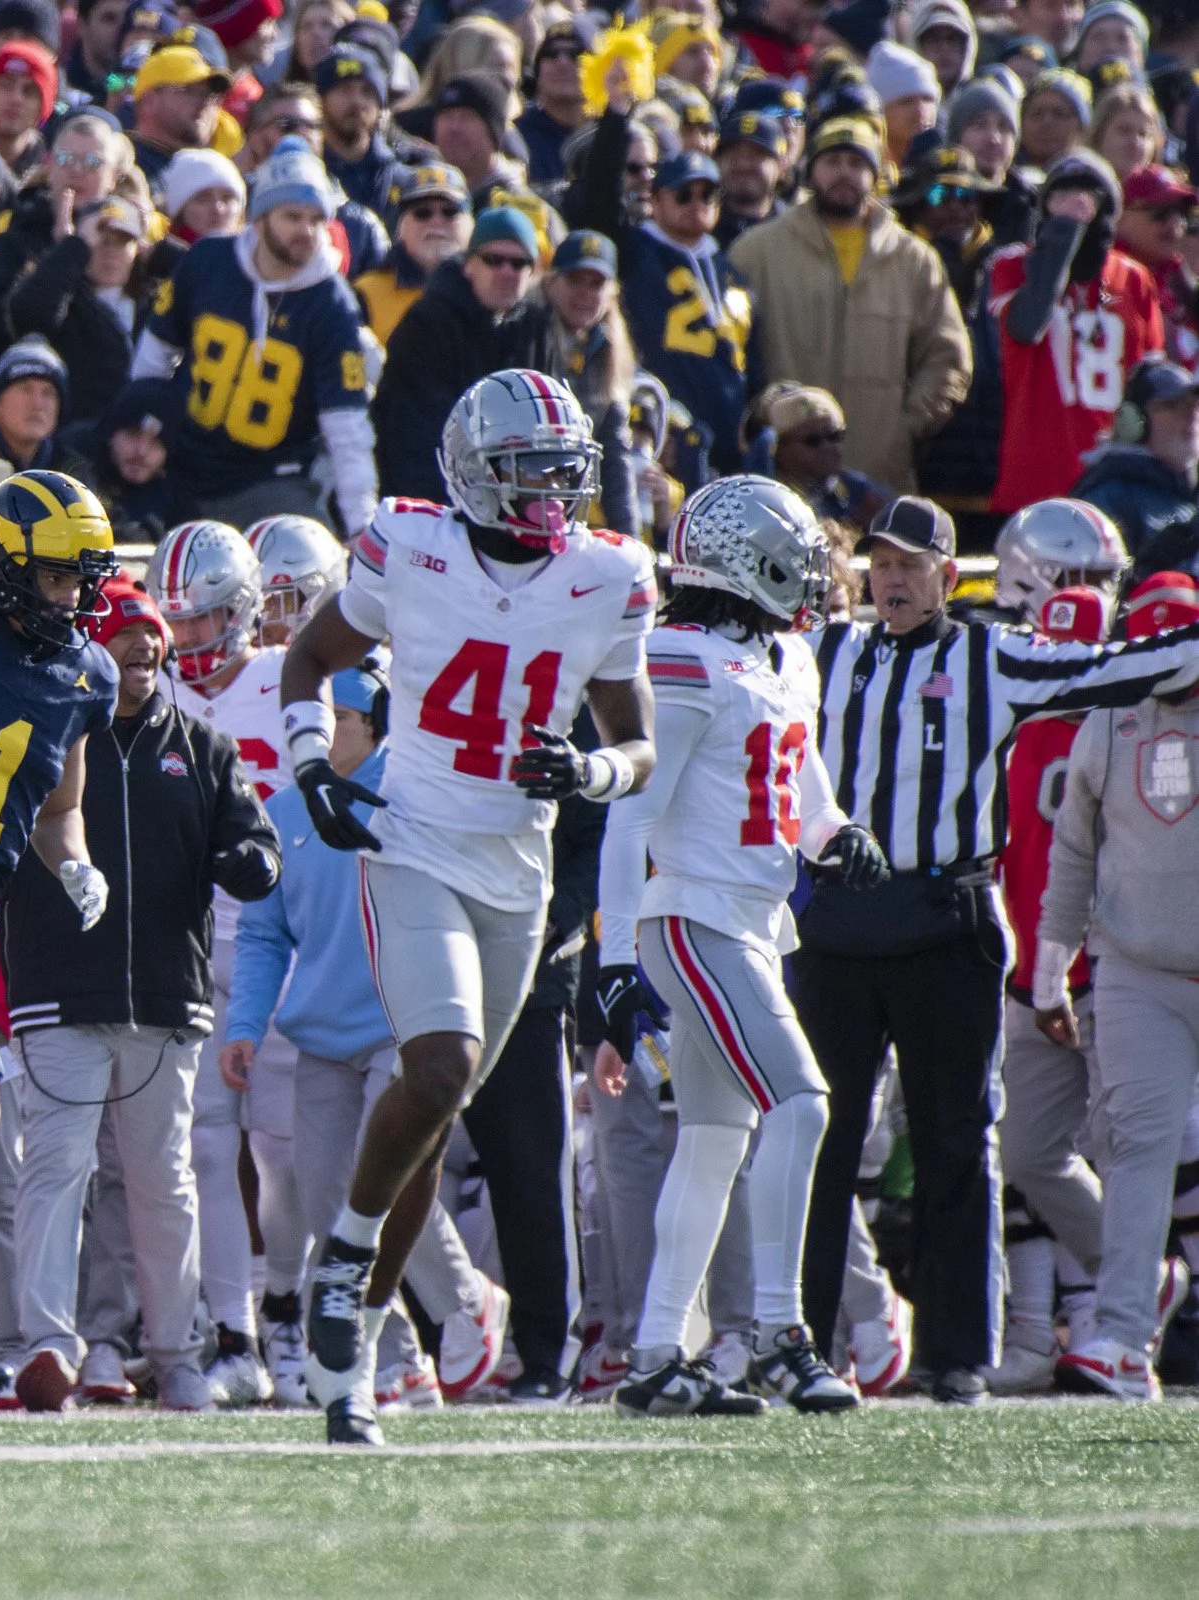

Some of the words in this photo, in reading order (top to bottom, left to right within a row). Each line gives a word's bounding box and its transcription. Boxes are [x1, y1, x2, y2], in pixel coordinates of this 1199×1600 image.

[188, 313, 302, 449] 88
[418, 638, 563, 782] 41
[924, 723, 943, 751] L
